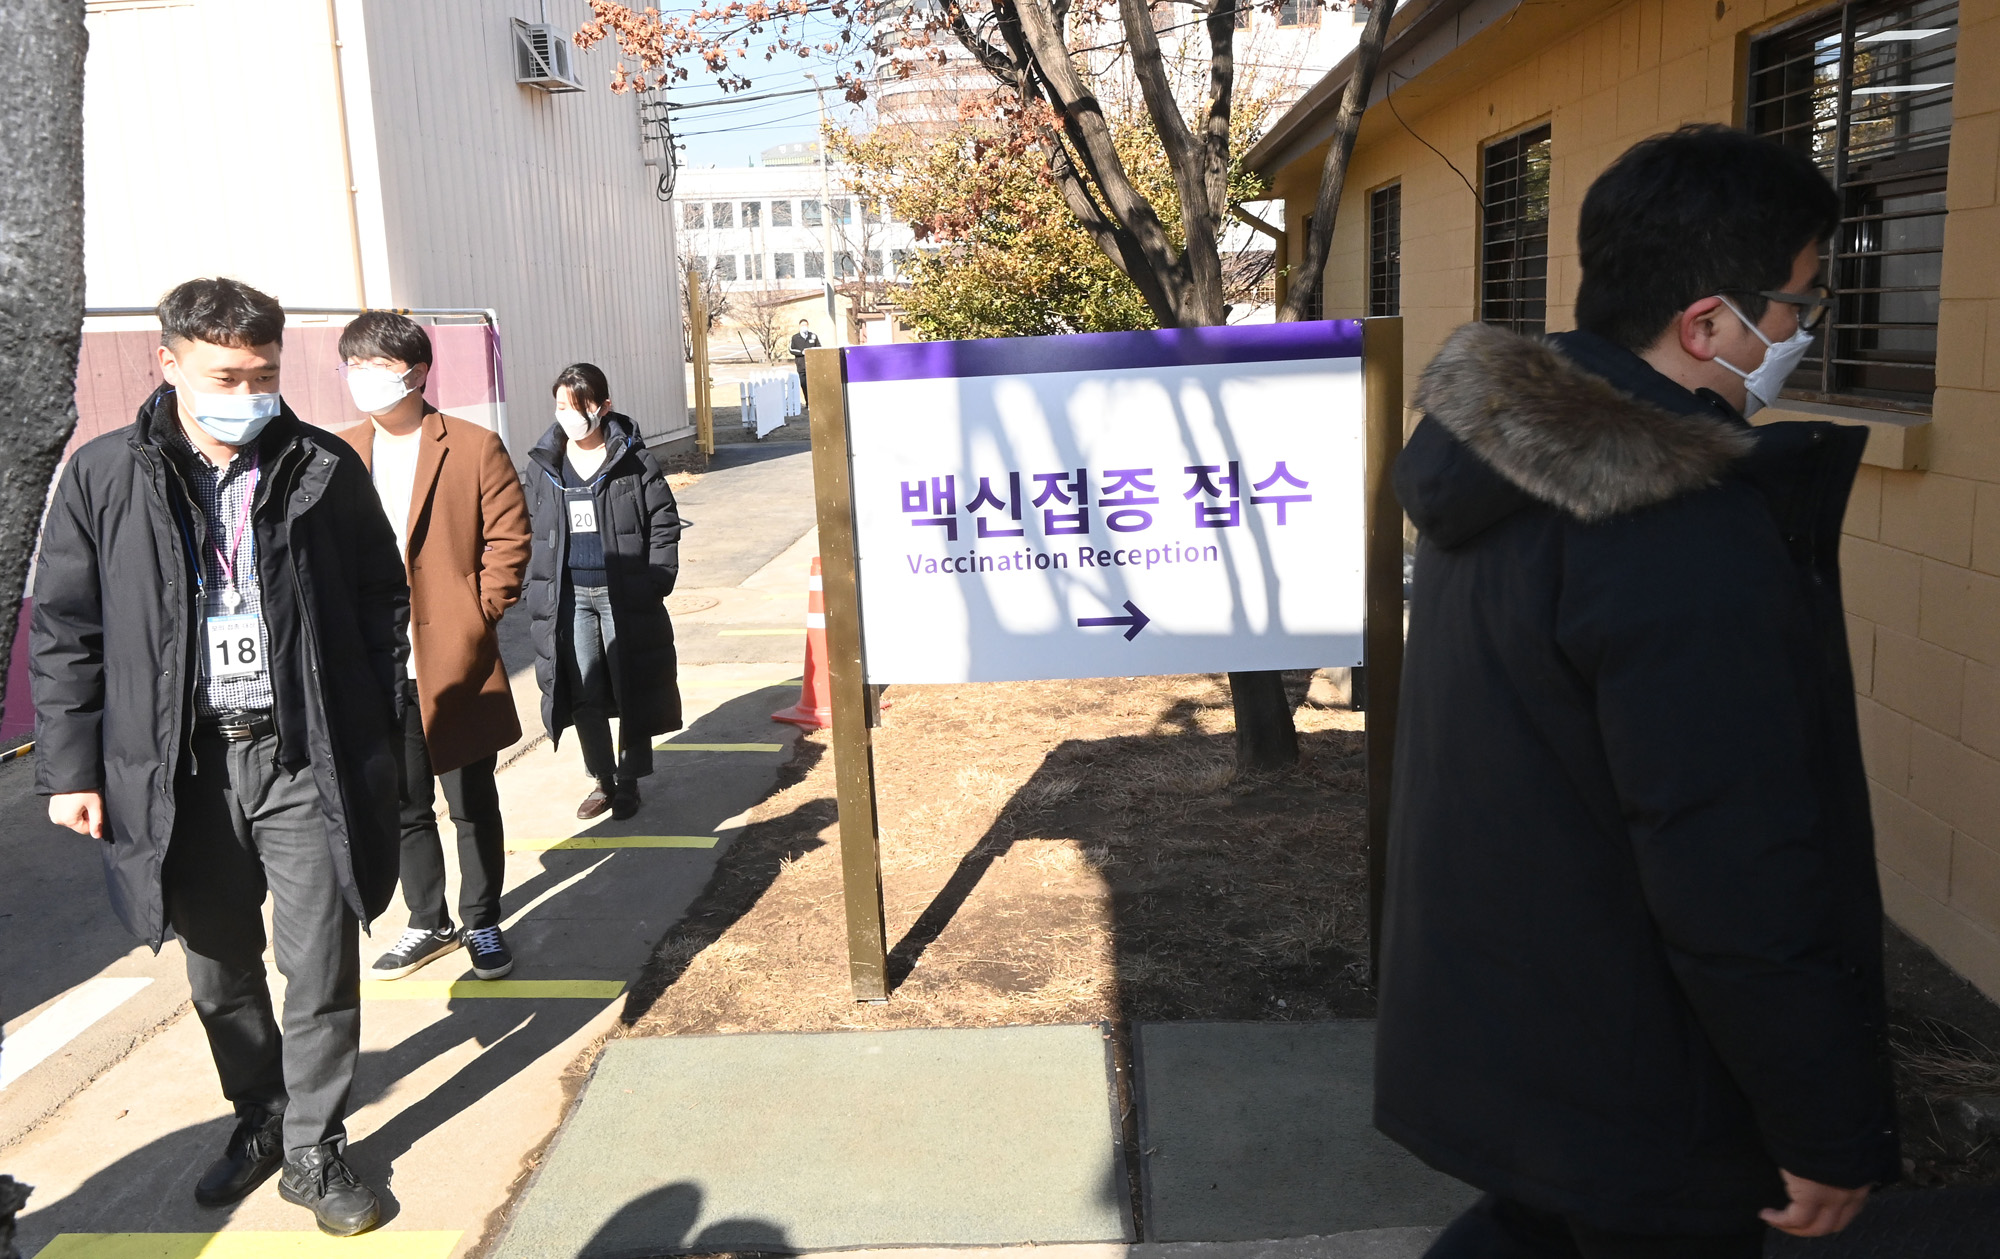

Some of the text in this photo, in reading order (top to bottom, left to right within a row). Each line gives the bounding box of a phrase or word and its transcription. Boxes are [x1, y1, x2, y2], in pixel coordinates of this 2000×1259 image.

[901, 460, 1312, 541] 백신접종 접수
[574, 513, 593, 527] 20
[906, 541, 1218, 574] Vaccination Reception
[216, 637, 256, 666] 18
